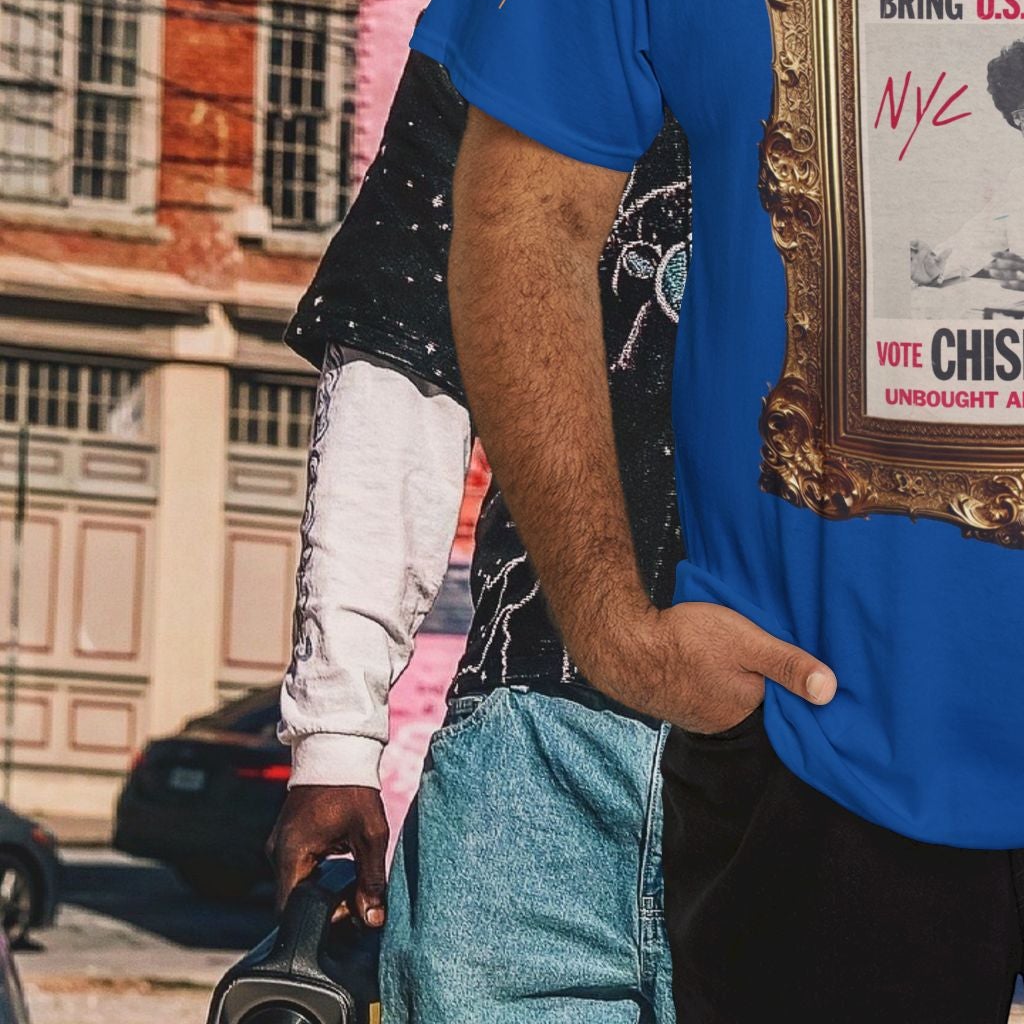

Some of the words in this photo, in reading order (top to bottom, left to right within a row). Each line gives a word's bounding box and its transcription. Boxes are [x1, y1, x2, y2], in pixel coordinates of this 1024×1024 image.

[874, 70, 972, 161] NYC
[876, 341, 923, 368] VOTE
[885, 387, 999, 408] UNBOUGHT
